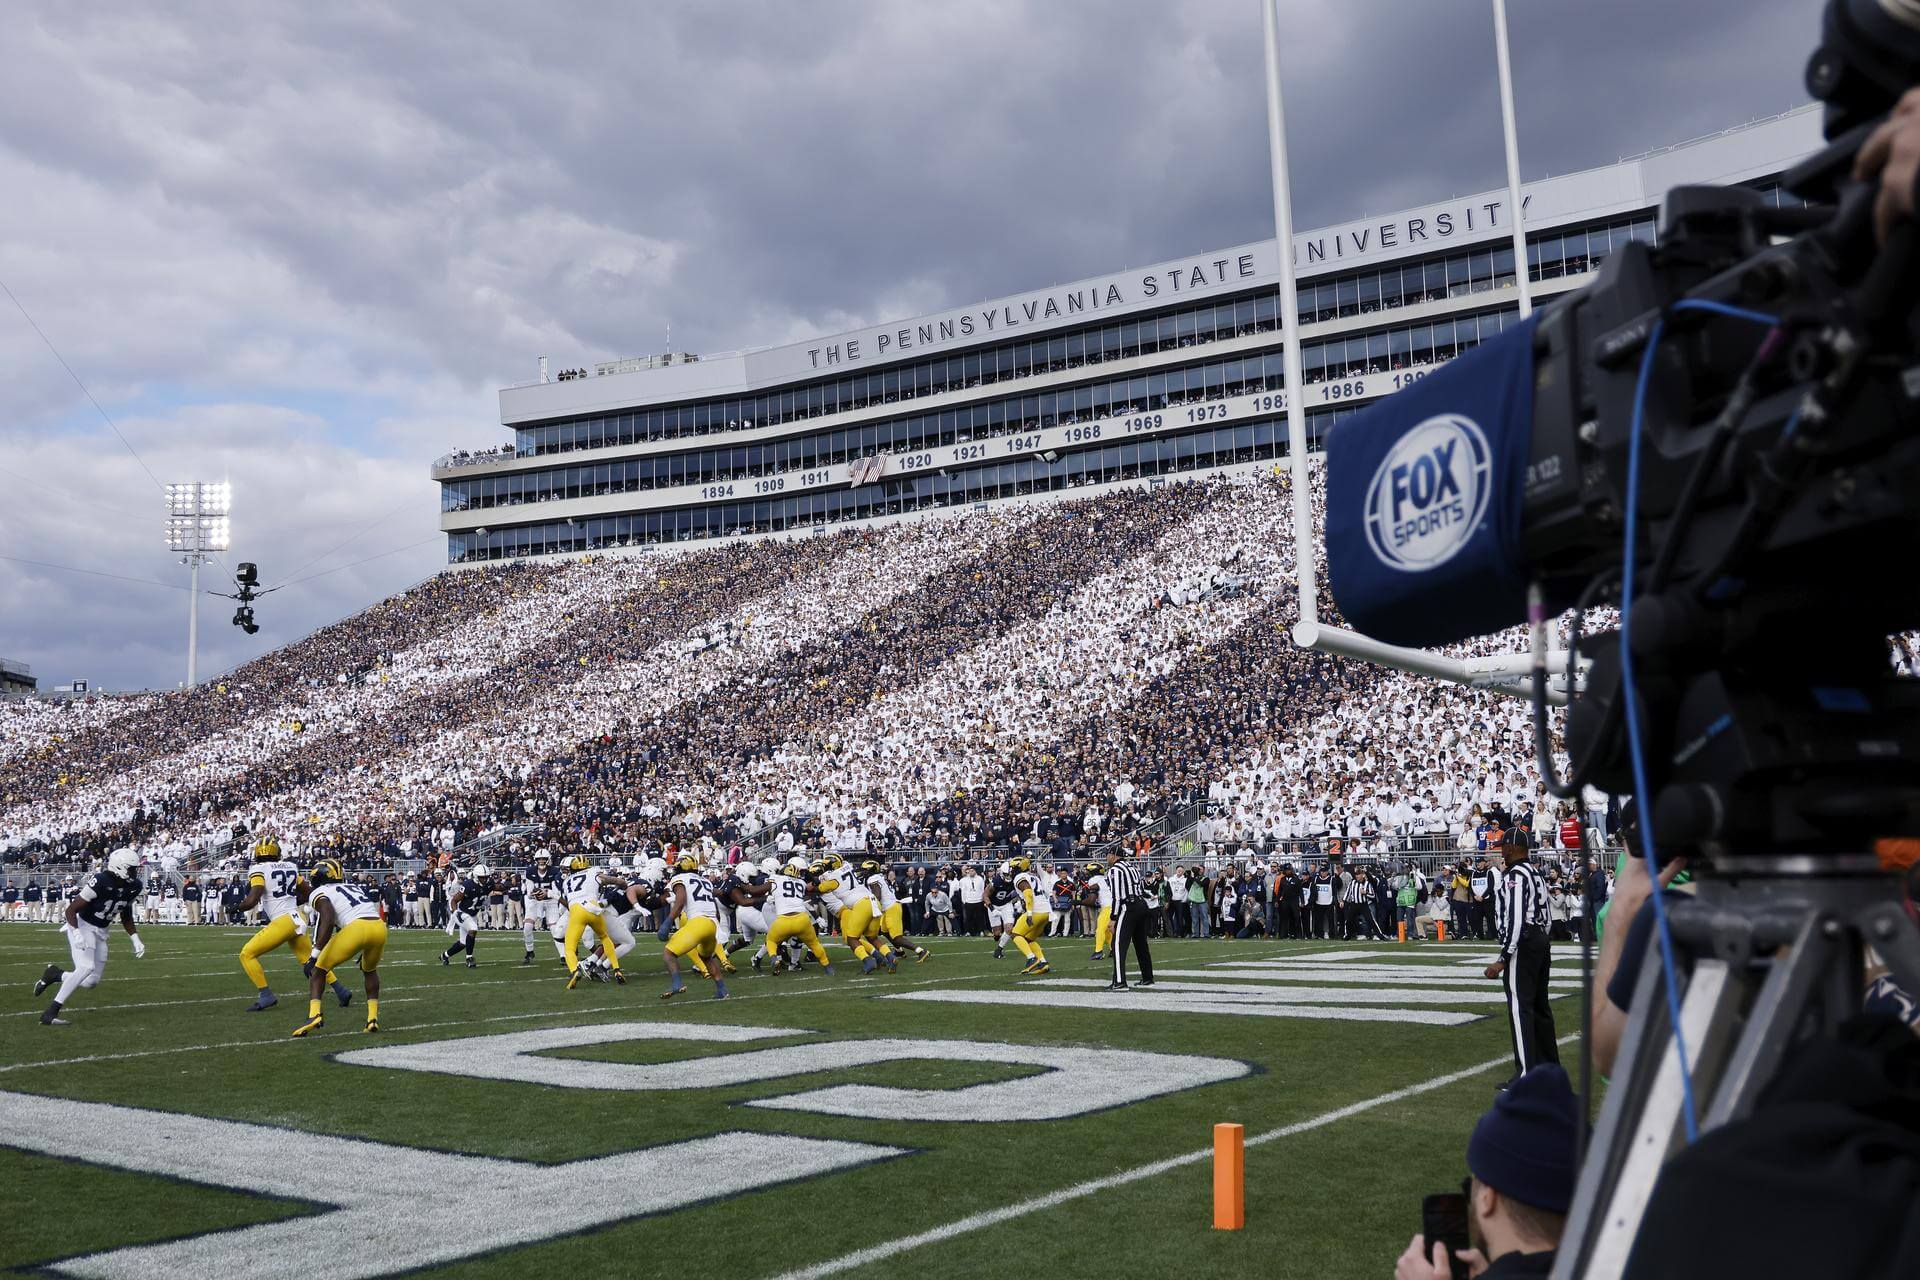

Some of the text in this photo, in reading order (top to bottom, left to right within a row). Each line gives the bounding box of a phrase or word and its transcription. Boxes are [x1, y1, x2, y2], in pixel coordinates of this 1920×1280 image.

[808, 194, 1533, 368] THE PENNSYLVANIA STATE NIVERSITY
[1392, 369, 1437, 390] 199
[1322, 381, 1365, 400] 1986
[1187, 404, 1227, 422] 1973
[1124, 414, 1164, 433] 1969
[1064, 425, 1101, 443] 1968
[953, 444, 986, 461] 1921
[1006, 435, 1042, 452] 1947
[899, 453, 932, 470] 1920
[754, 478, 785, 493] 1909
[801, 470, 830, 486] 1911
[1392, 437, 1460, 523] FOX
[701, 485, 734, 499] 1894
[1394, 500, 1464, 547] SPORTS
[1330, 839, 1341, 855] 2
[271, 870, 297, 898] 32
[567, 874, 587, 893] 17
[782, 881, 806, 899] 99
